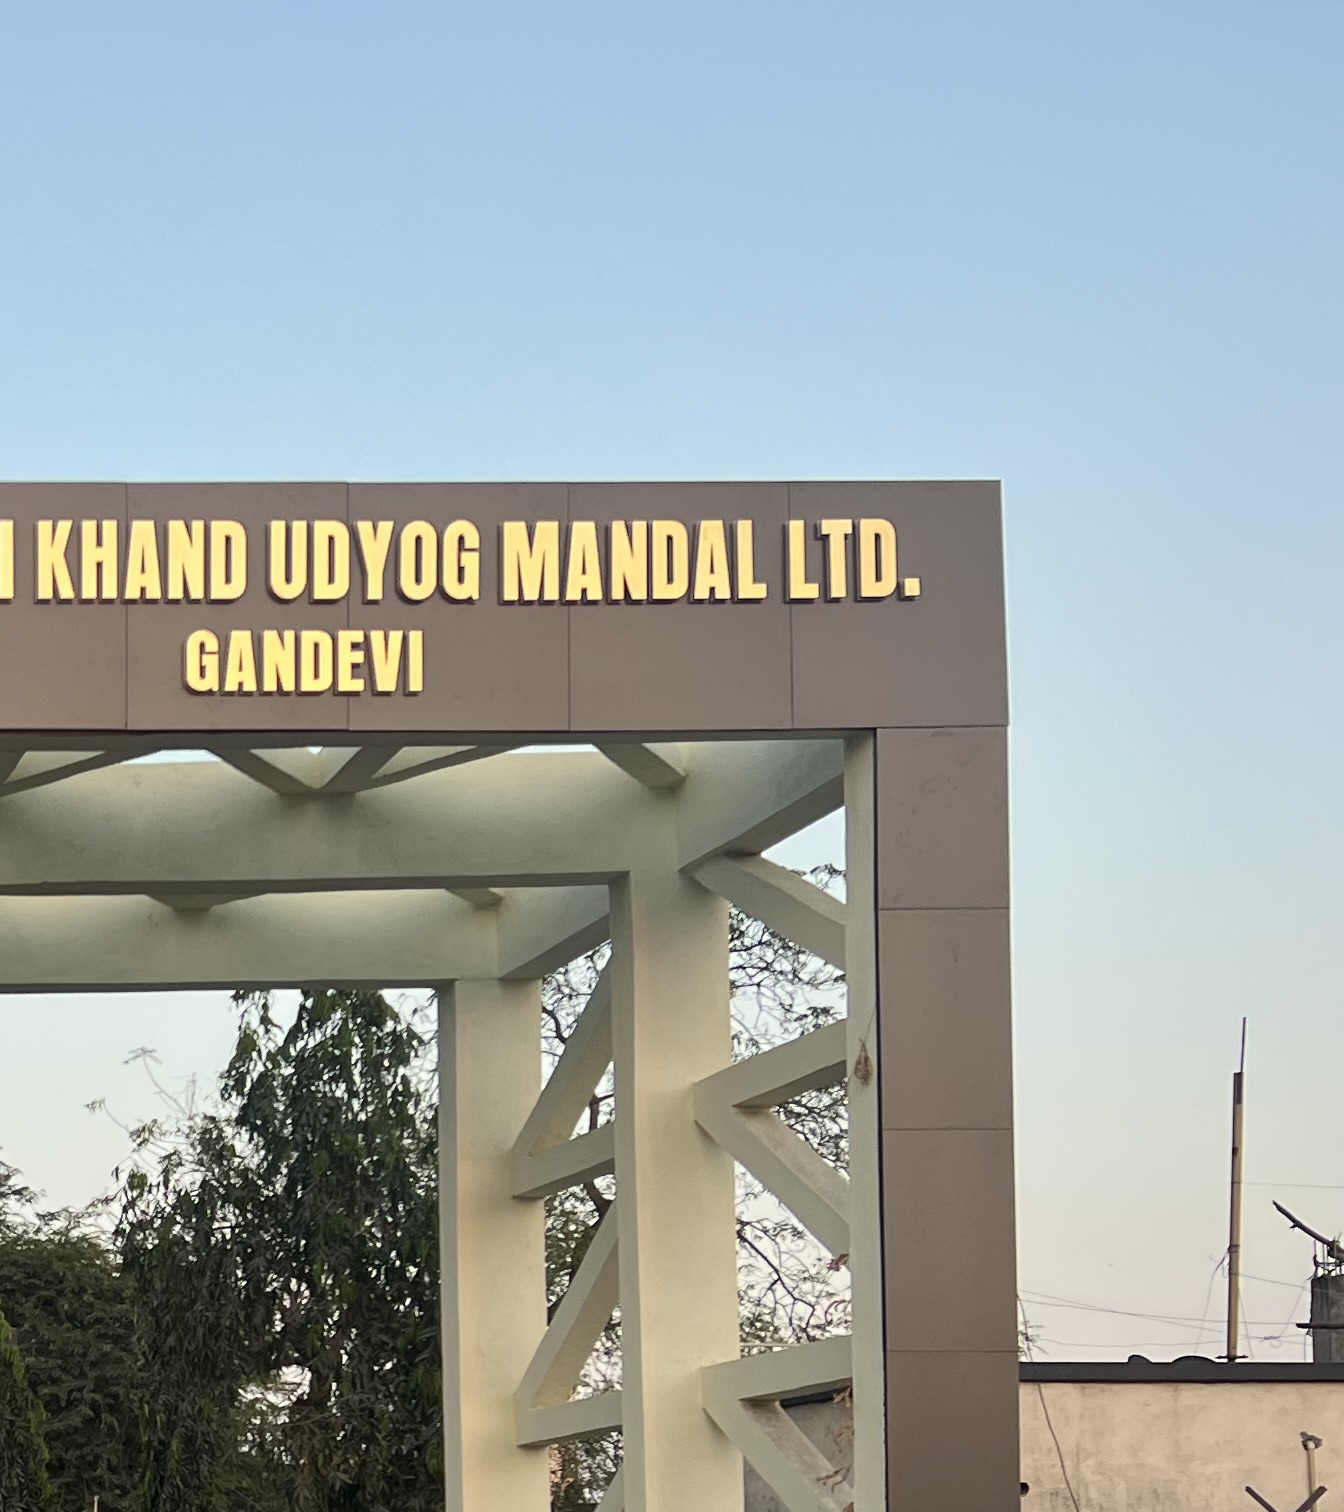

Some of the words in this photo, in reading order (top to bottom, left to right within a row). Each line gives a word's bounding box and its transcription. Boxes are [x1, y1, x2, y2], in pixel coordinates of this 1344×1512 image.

[36, 518, 248, 601] KHAND
[269, 518, 481, 601] UDYOG
[502, 519, 768, 602] MANDAL
[788, 517, 921, 600] LTD.
[185, 628, 425, 693] GANDEVI
